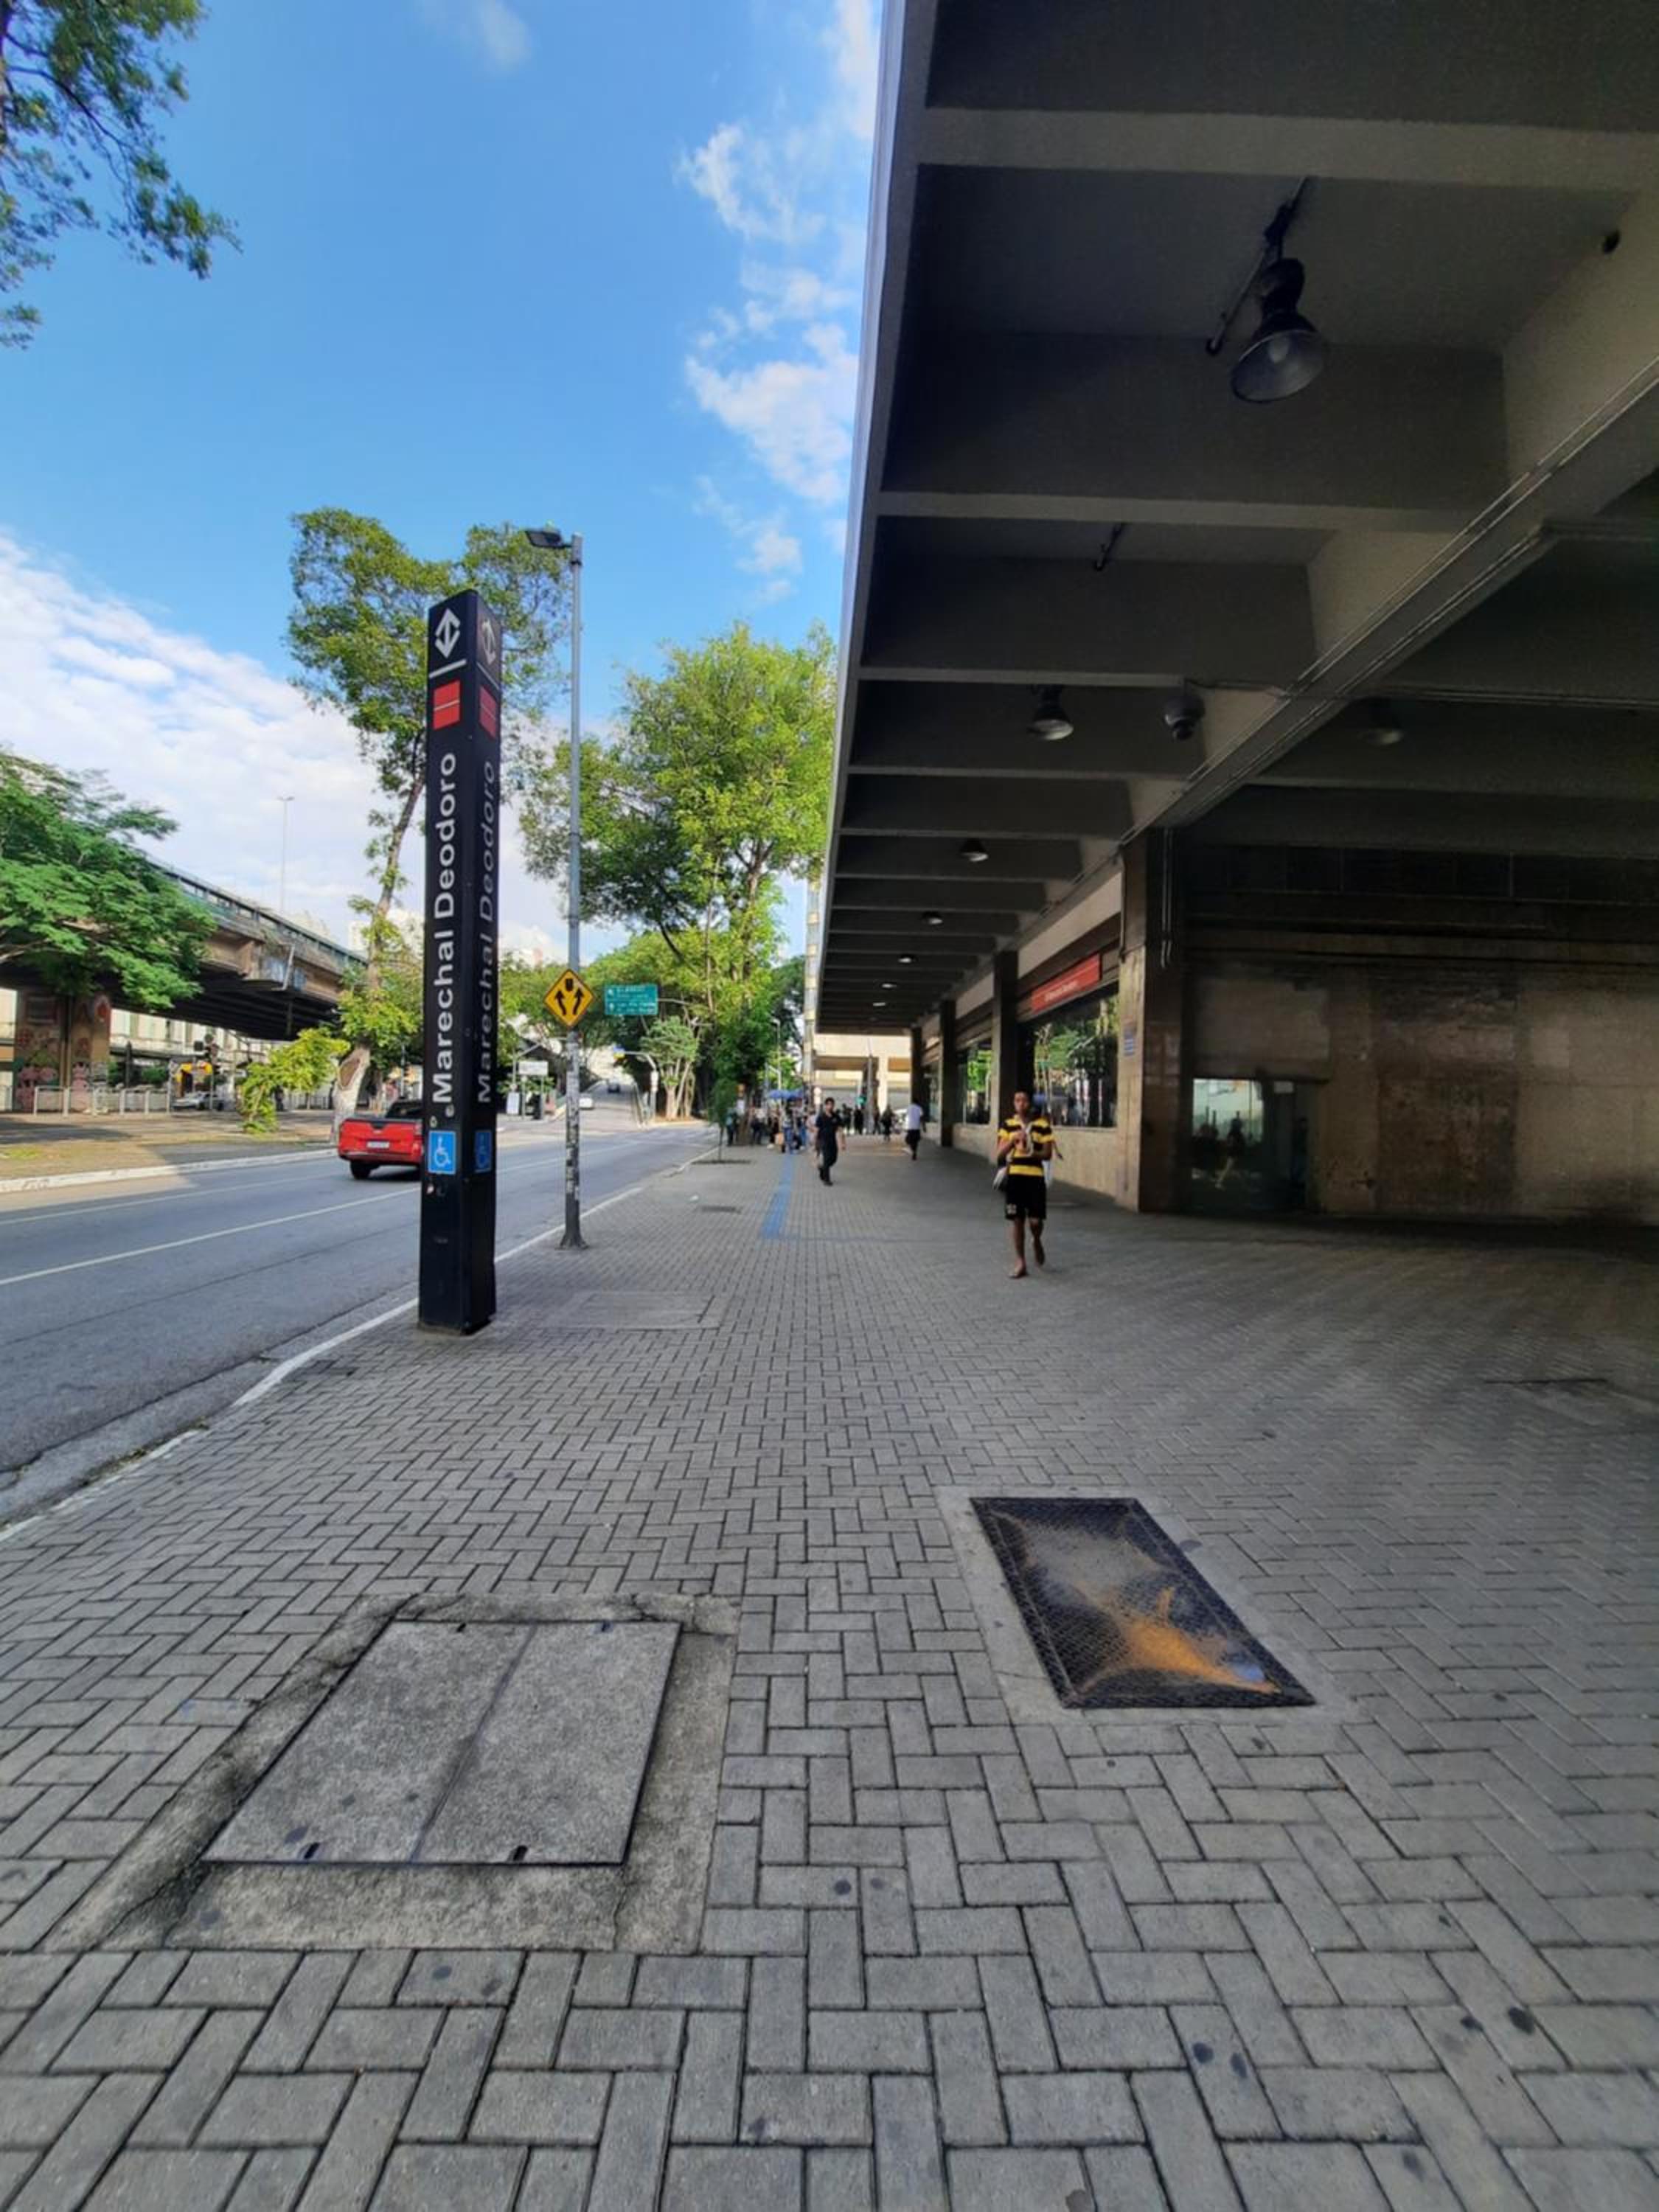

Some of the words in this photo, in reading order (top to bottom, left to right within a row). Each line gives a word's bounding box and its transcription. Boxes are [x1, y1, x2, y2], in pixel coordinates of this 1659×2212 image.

[434, 752, 456, 919] Deodoro
[480, 761, 496, 921] Deodoro
[431, 930, 455, 1104] Marechal
[478, 935, 495, 1103] Marechal
